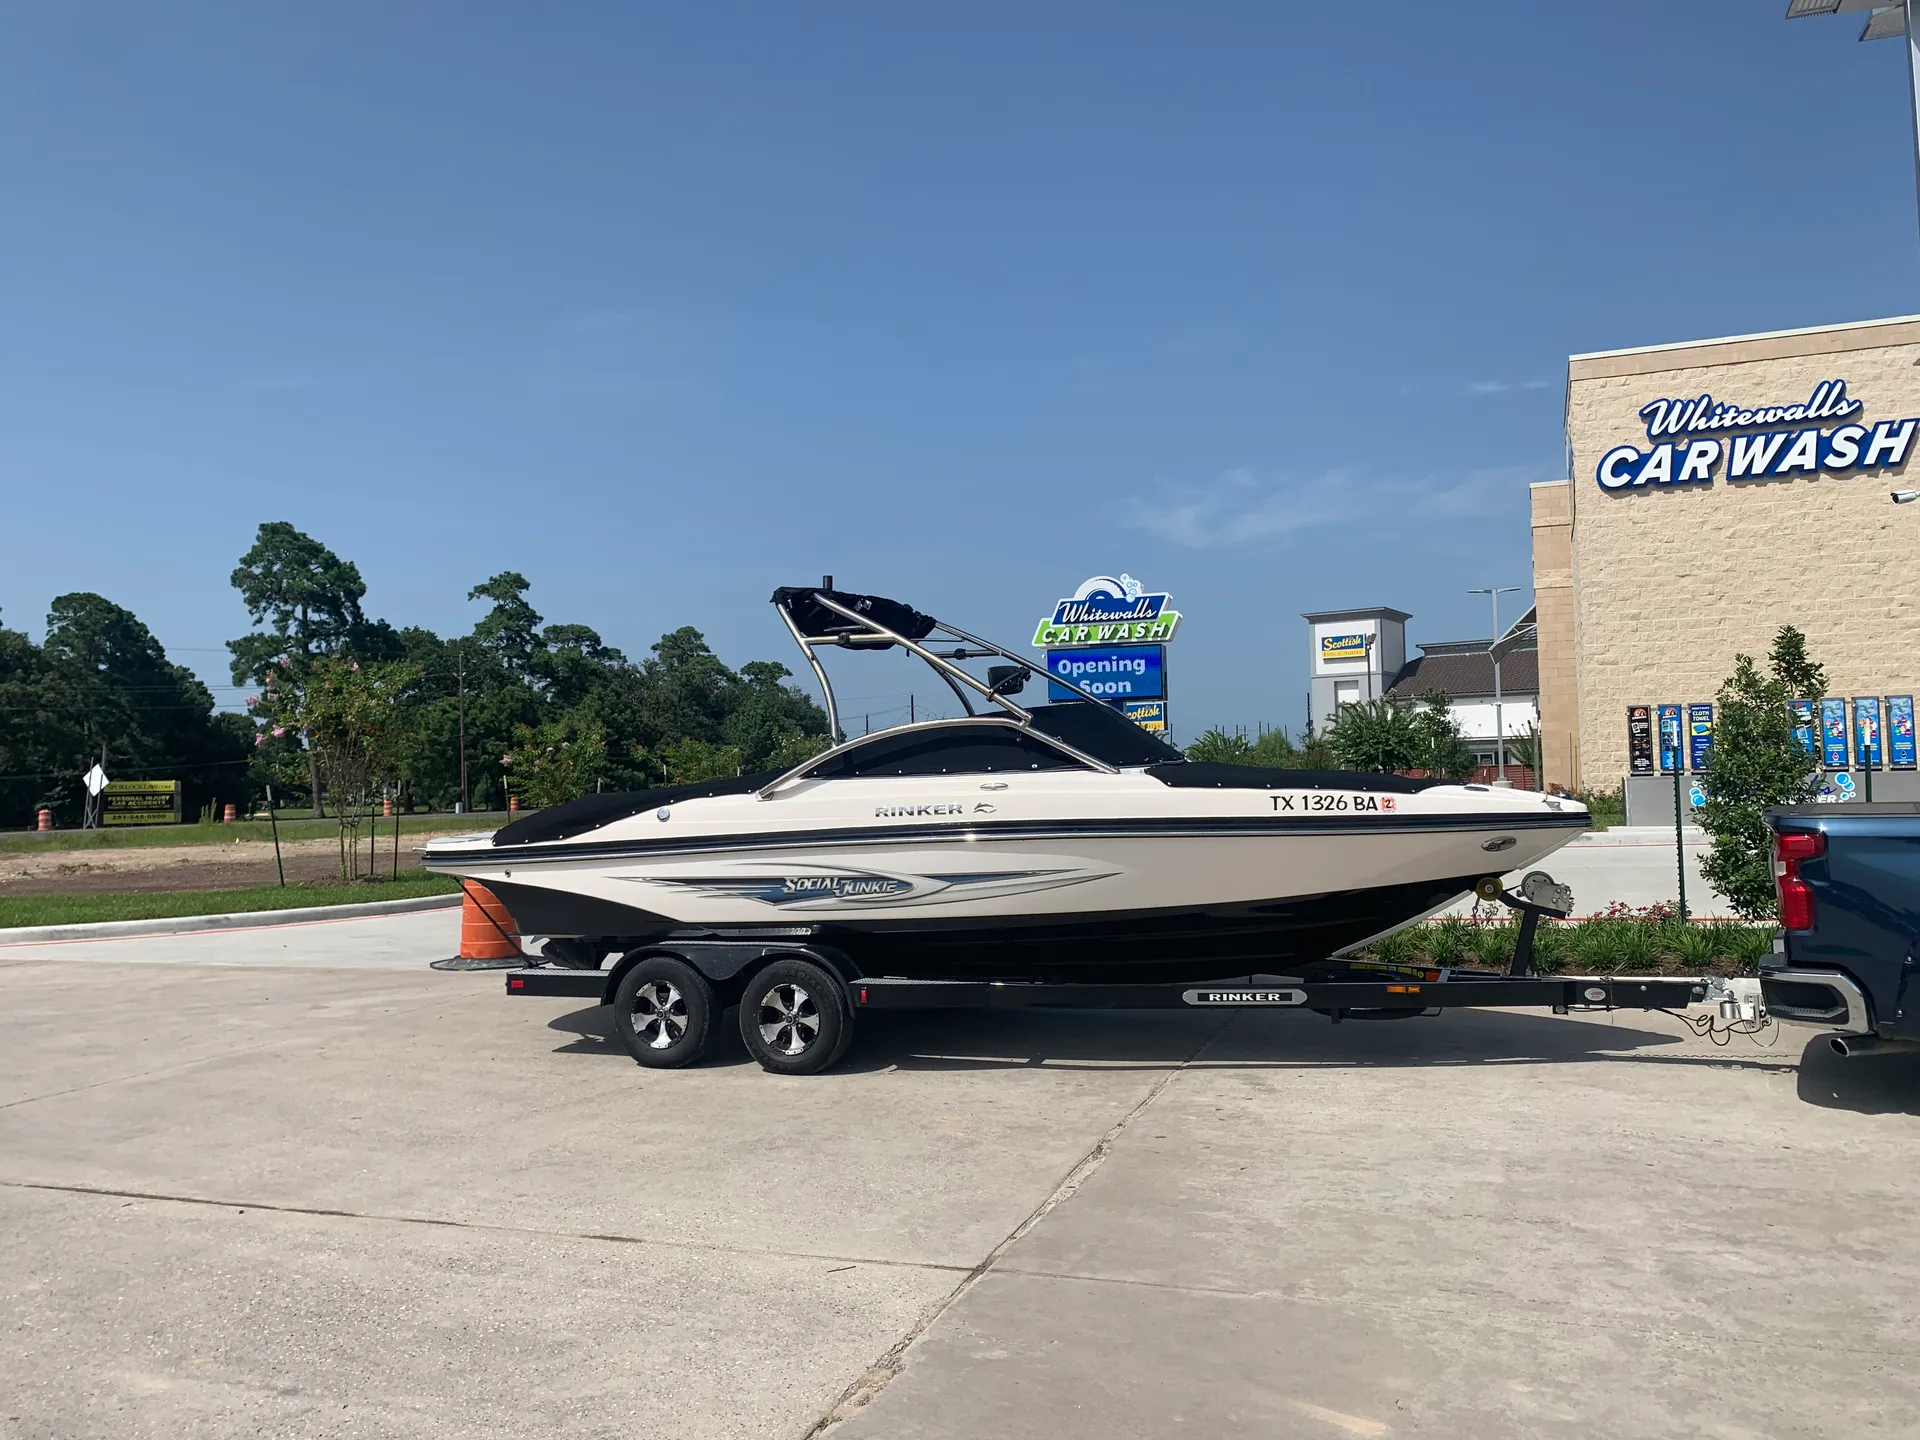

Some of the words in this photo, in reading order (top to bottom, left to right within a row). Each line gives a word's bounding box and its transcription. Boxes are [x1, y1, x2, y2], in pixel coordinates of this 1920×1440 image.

[1643, 379, 1860, 437] Whitewalls
[1600, 439, 1720, 489] CAR
[1730, 420, 1917, 477] WASH
[1059, 598, 1157, 623] Whitewalls
[1042, 627, 1088, 643] CAR
[1098, 622, 1165, 640] WASH
[1324, 636, 1361, 650] Scottish
[1057, 656, 1146, 678] Opening
[1079, 679, 1132, 694] Soon
[1126, 704, 1161, 720] cottish
[875, 803, 963, 817] RINKER
[1269, 795, 1295, 811] TX
[1301, 795, 1348, 811] 1326
[1352, 796, 1379, 811] BA
[781, 876, 841, 894] SOCIAL
[832, 879, 899, 898] JUNKIE
[1208, 992, 1281, 1002] RINKER
